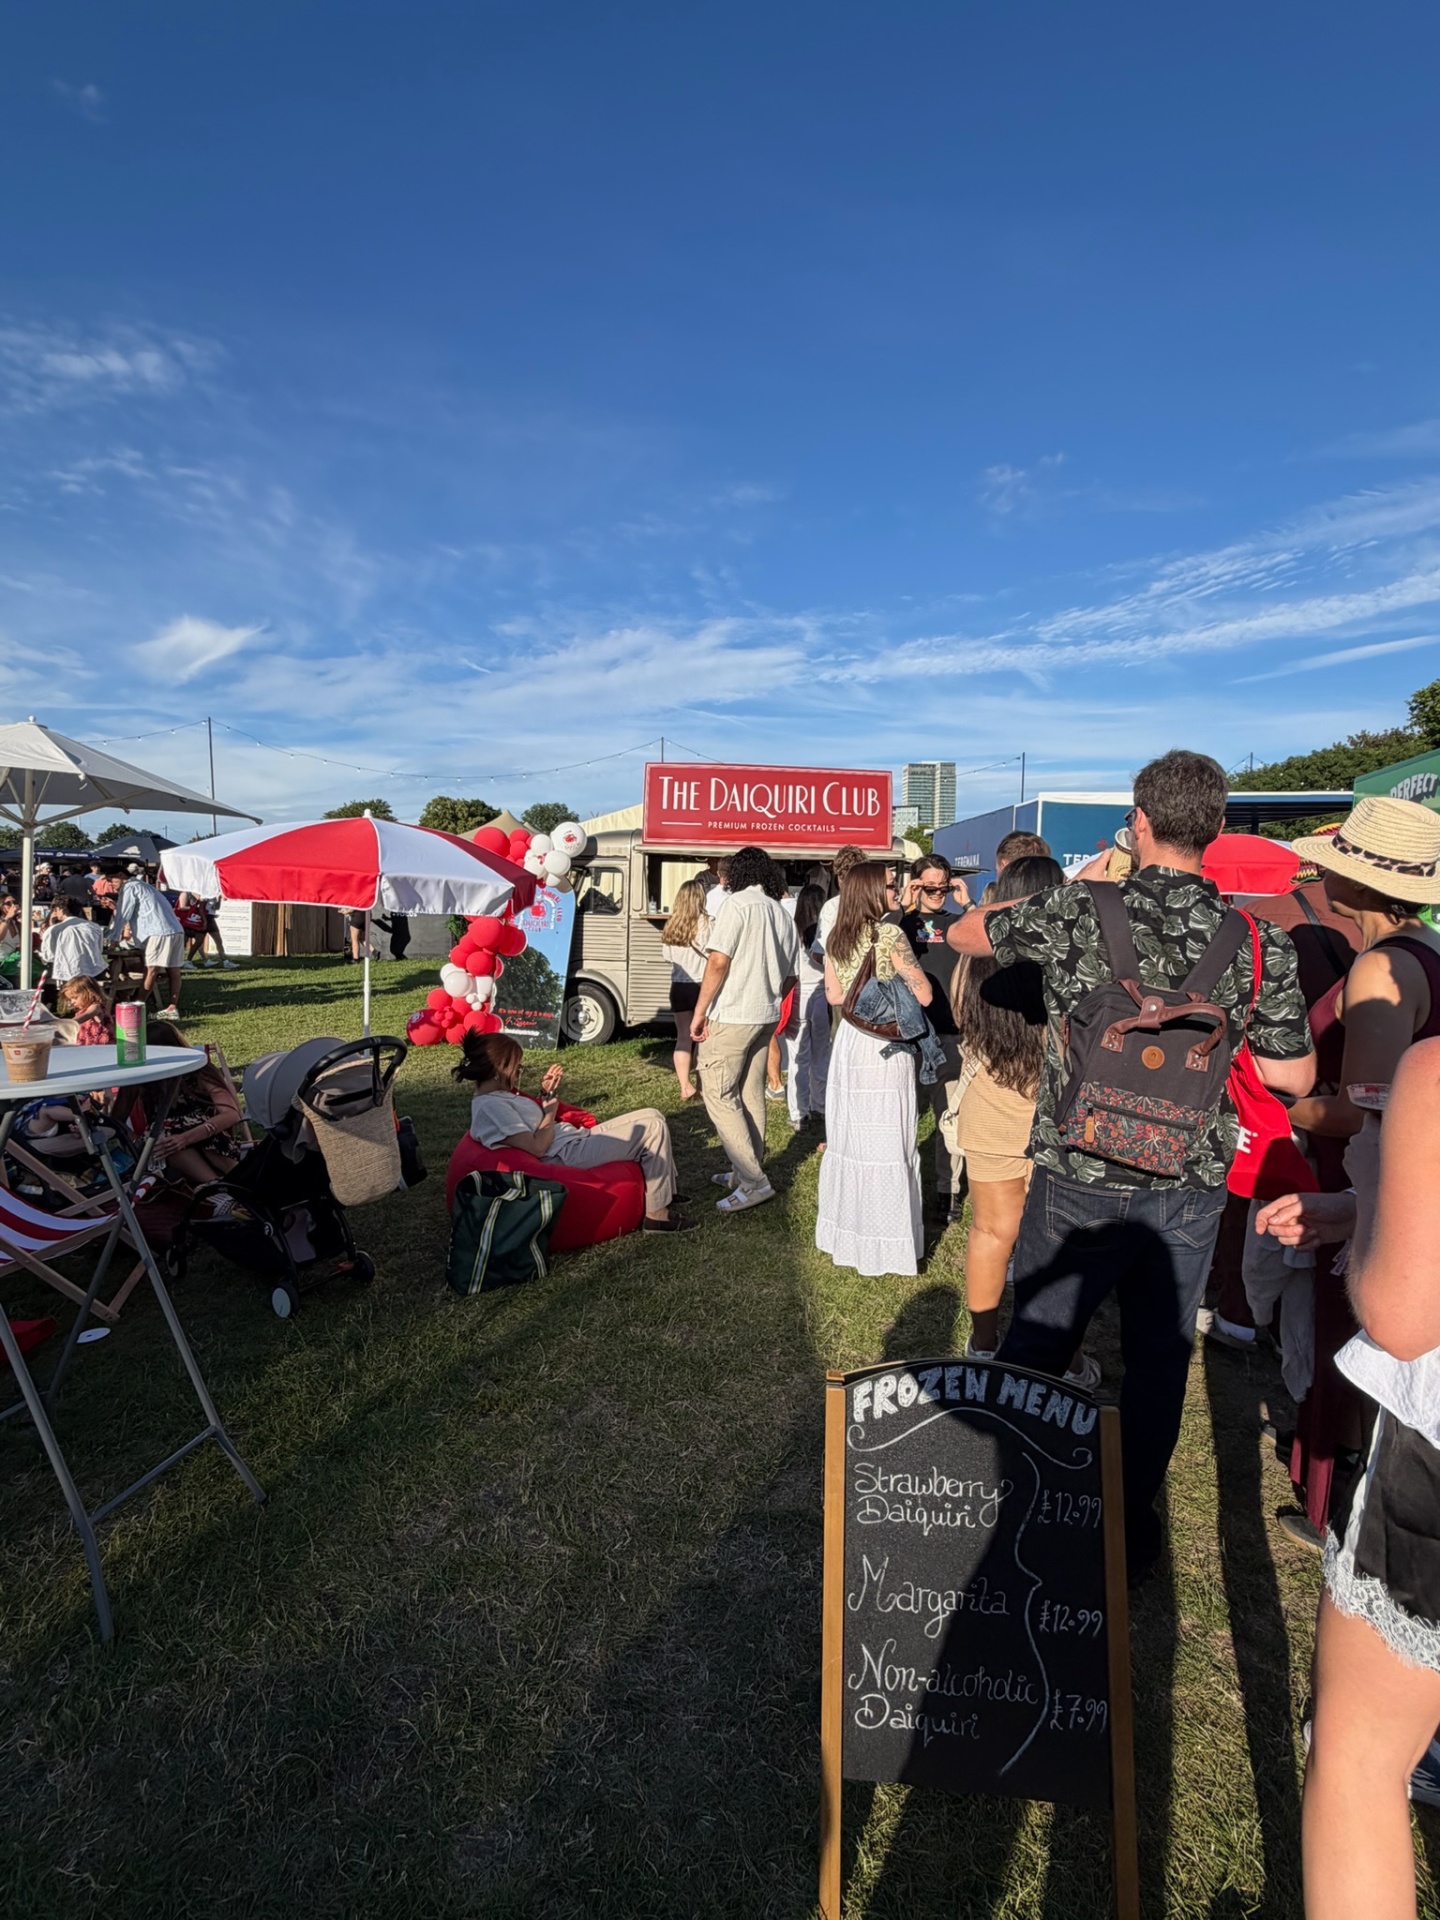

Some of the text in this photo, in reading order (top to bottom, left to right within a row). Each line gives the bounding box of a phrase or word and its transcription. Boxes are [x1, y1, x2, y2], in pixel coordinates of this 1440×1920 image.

[658, 775, 881, 819] THE DAIQUIRI CLUB
[1390, 772, 1438, 800] PERFECT
[707, 820, 836, 833] PREMIUM FROZEN COCKTAILS
[954, 853, 980, 867] TEREMANA
[852, 1365, 1098, 1436] FROZEN MENU
[853, 1462, 1014, 1528] Strawberry
[856, 1494, 976, 1536] Daiquiri
[1037, 1489, 1102, 1529] £12.99
[847, 1554, 1010, 1639] Margarita
[1038, 1599, 1103, 1638] £12.99
[854, 1693, 981, 1748] Daiquiri
[1049, 1688, 1108, 1734] £7.99
